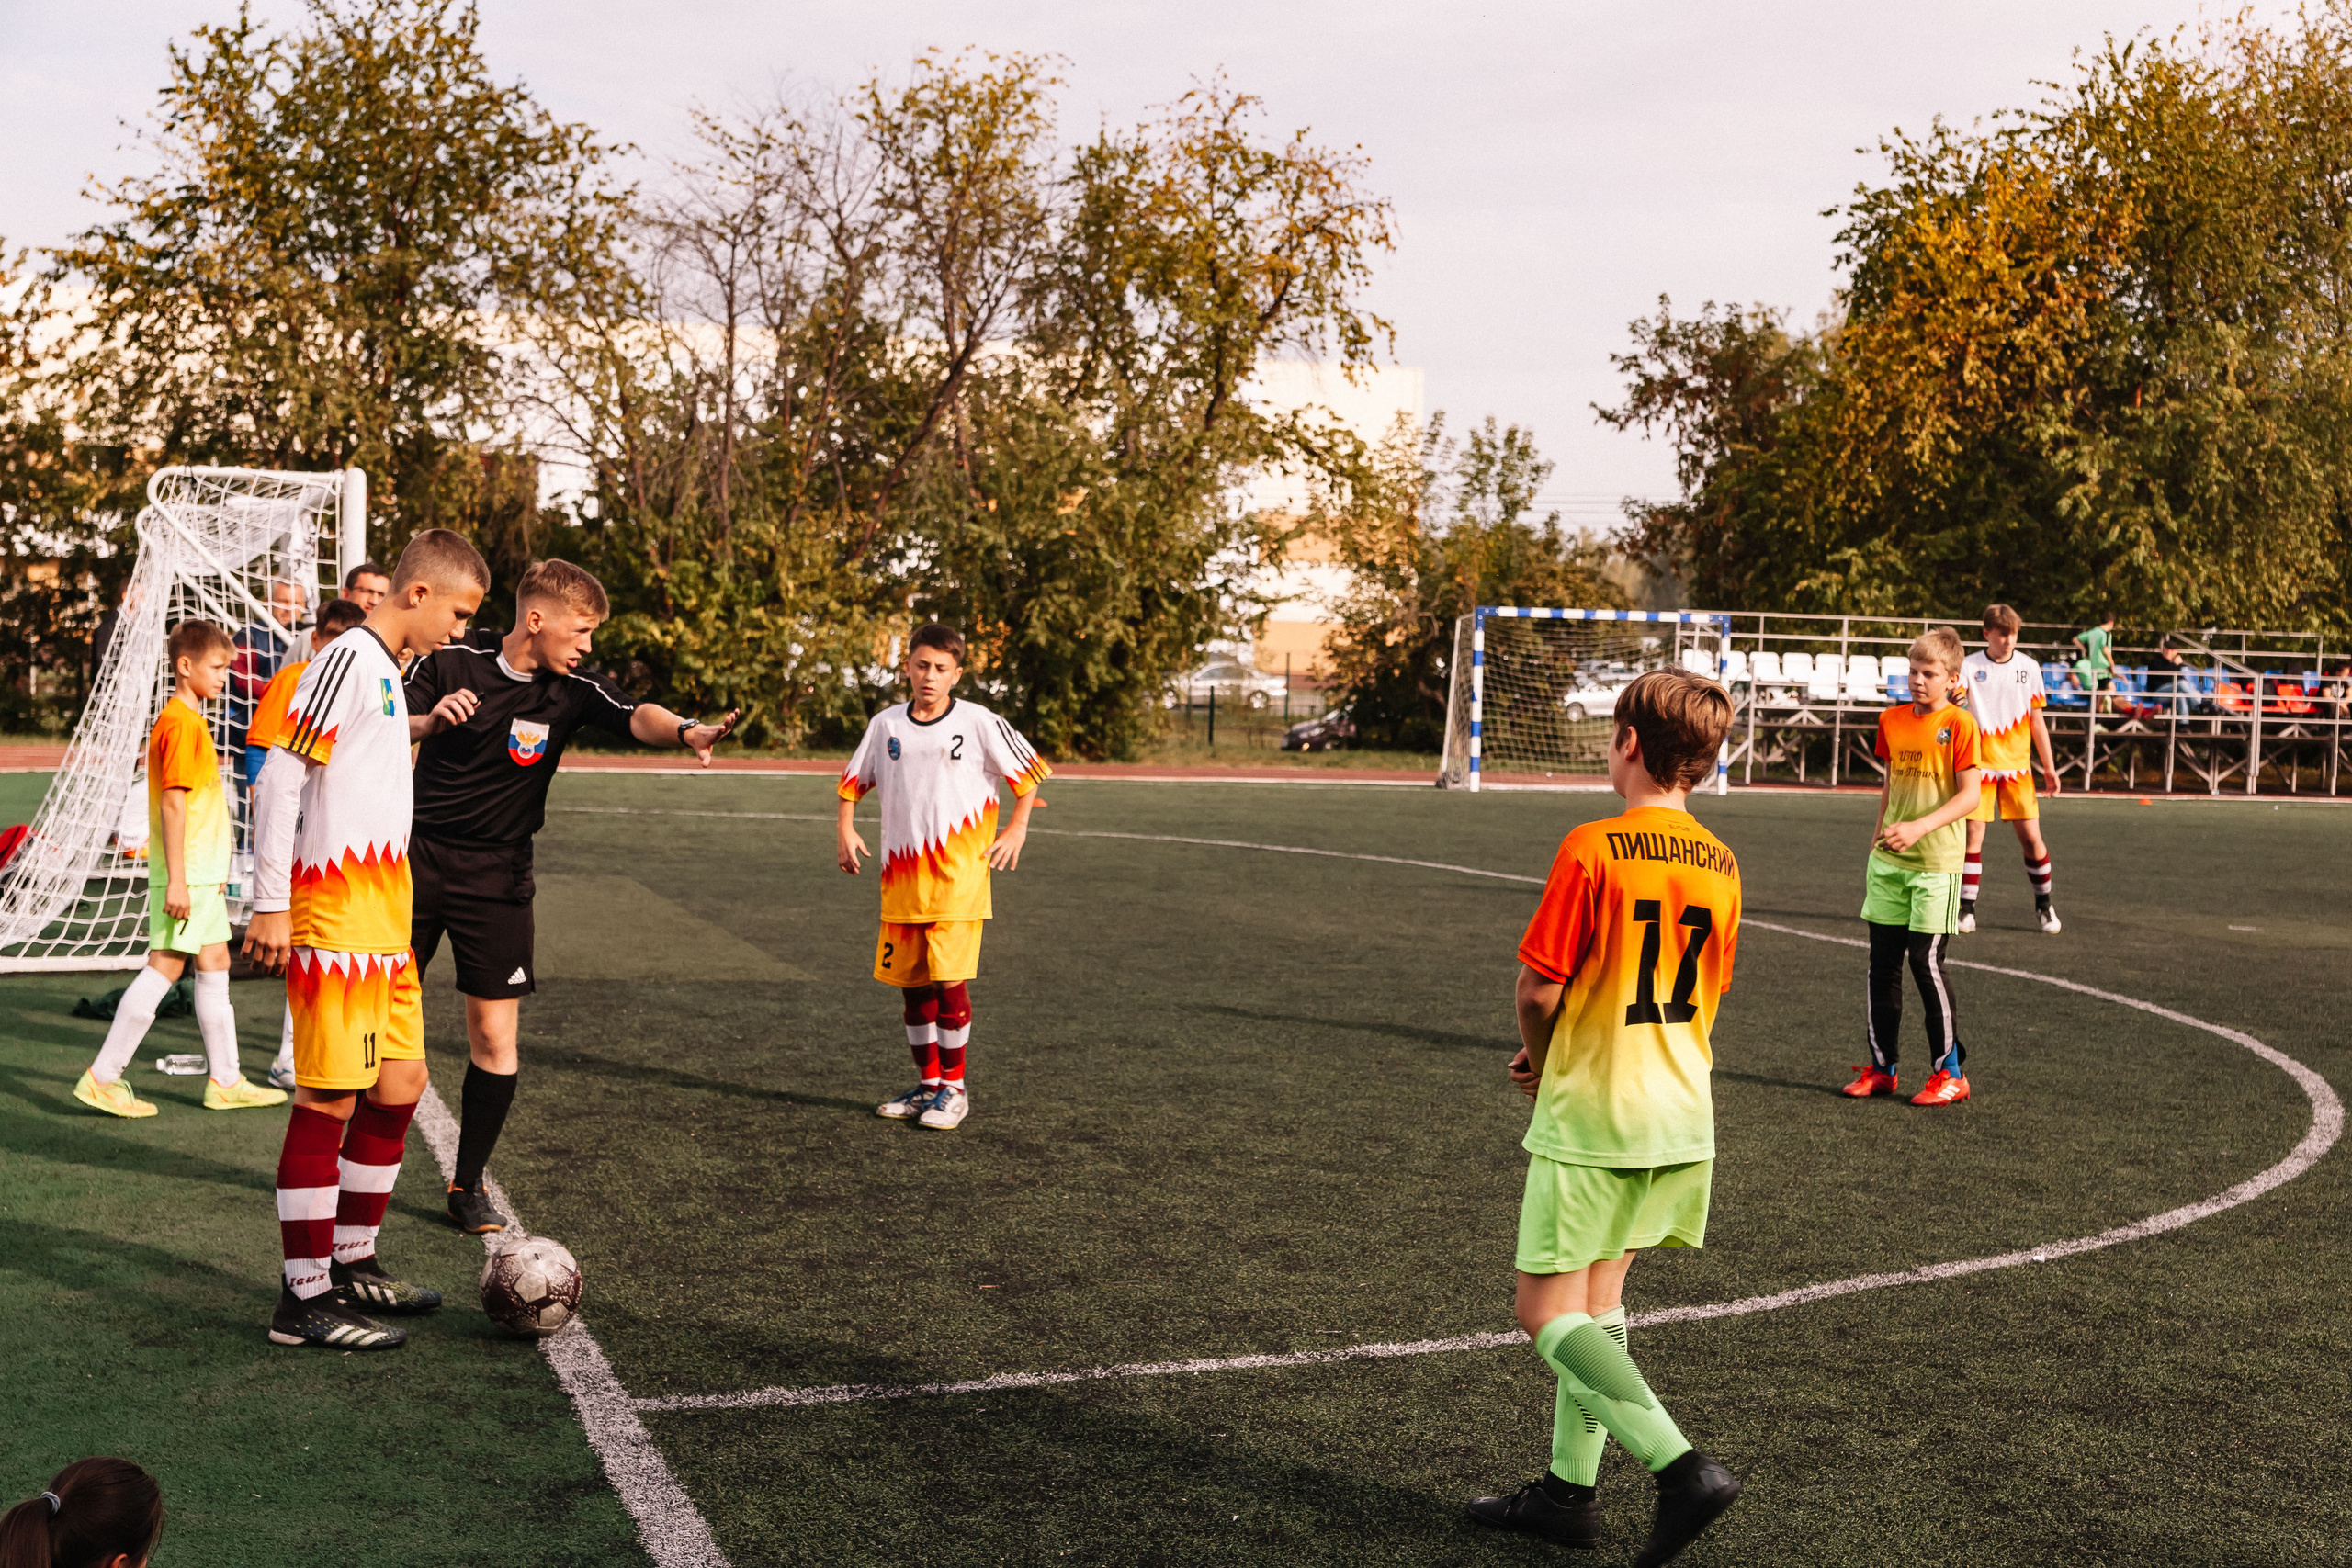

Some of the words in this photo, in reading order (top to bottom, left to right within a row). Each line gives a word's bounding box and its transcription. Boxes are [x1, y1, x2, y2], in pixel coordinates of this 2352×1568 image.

[2016, 670, 2028, 683] 18
[950, 734, 964, 760] 2
[1606, 832, 1735, 879] ПИЩАНСКИЙ
[881, 942, 894, 969] 2
[1625, 899, 1712, 1026] 17
[364, 1032, 376, 1069] 11
